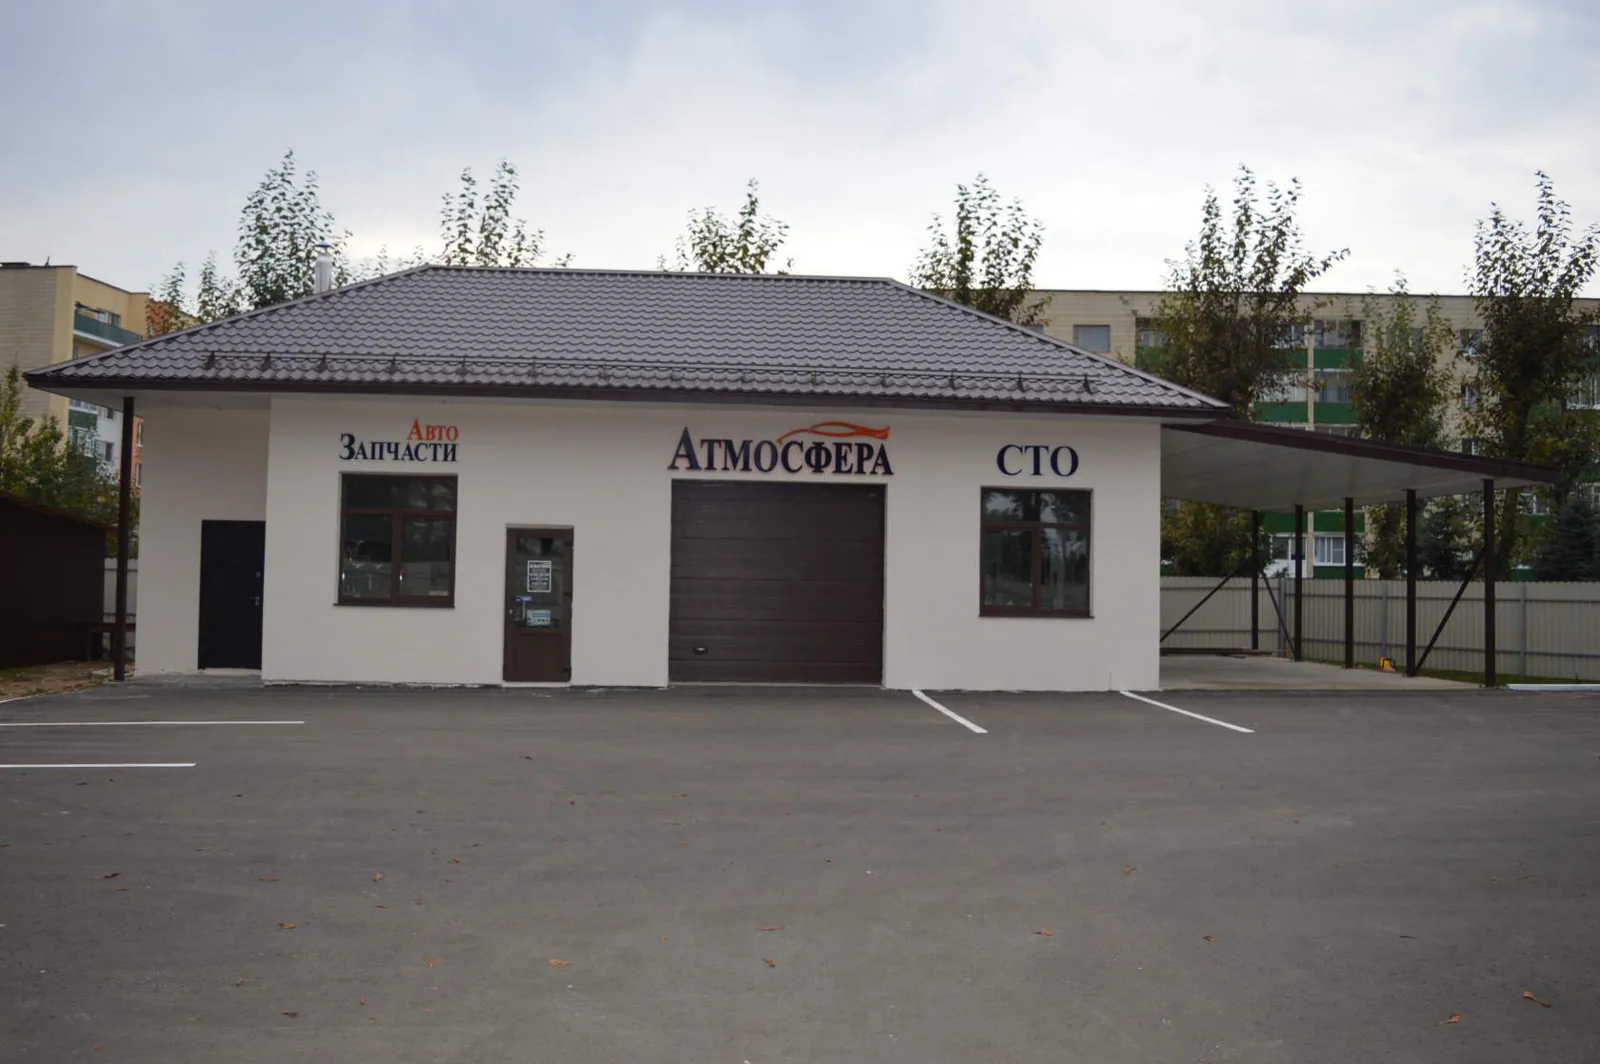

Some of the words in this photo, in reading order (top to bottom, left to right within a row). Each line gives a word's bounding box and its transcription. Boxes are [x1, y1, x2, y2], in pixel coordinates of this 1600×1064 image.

[407, 418, 459, 441] АВТО
[339, 433, 458, 462] ЗАПЧАСТИ
[667, 426, 894, 475] АТМОСФЕРА
[996, 444, 1079, 477] СТО
